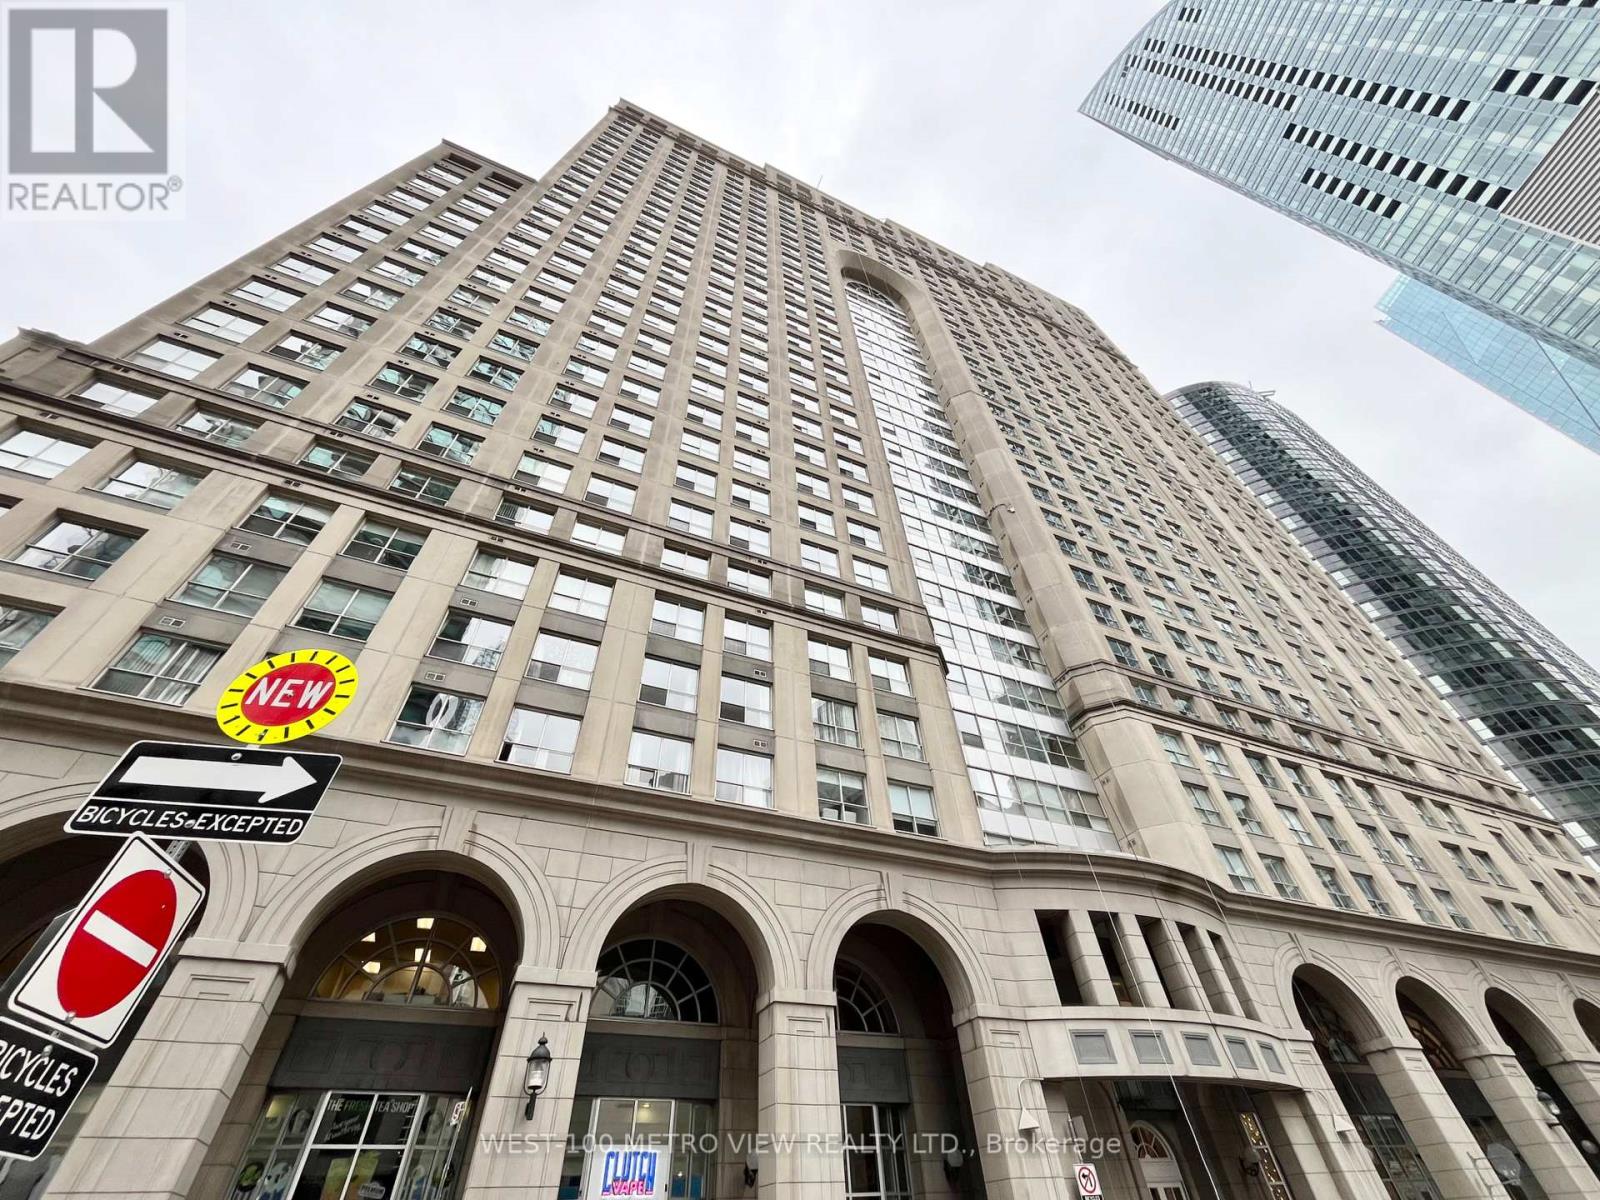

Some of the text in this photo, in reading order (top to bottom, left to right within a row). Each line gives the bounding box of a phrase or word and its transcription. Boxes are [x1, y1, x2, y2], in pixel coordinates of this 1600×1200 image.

[245, 677, 335, 710] NEW
[76, 806, 305, 836] BICYCLES EXCEPTED
[327, 1098, 346, 1111] THE
[601, 1151, 658, 1195] CLUTCH
[612, 1176, 645, 1195] VAPE
